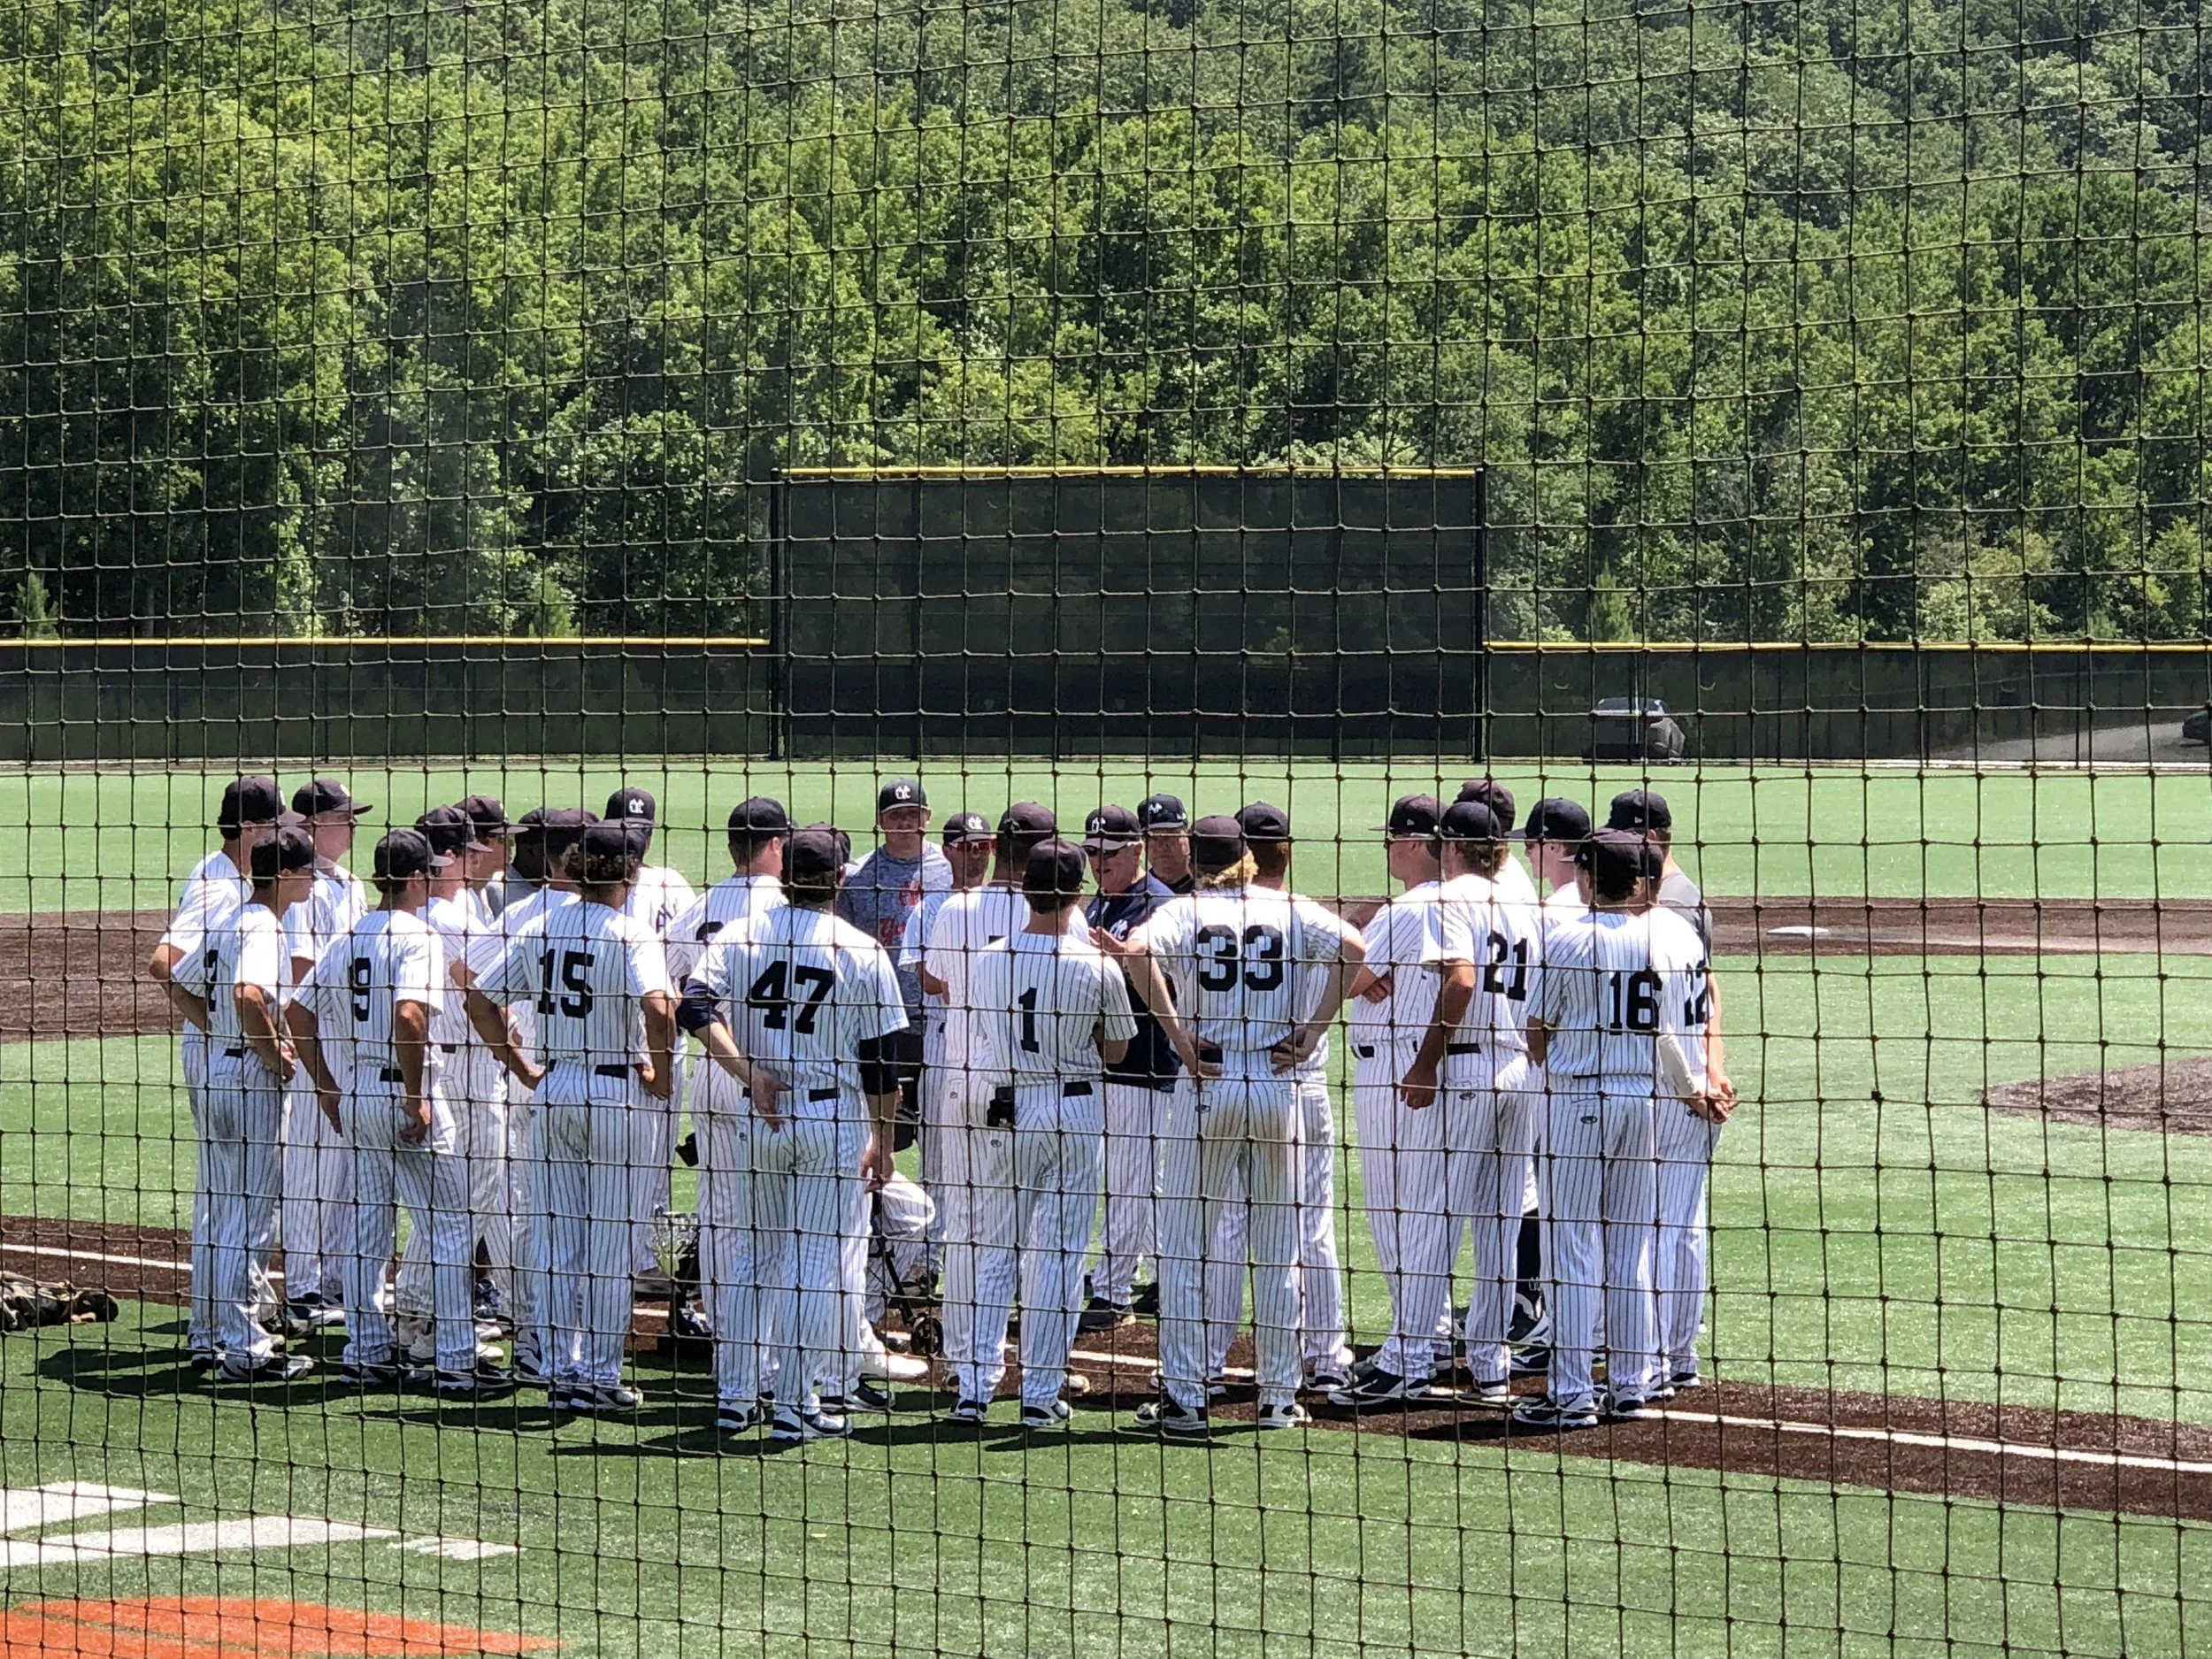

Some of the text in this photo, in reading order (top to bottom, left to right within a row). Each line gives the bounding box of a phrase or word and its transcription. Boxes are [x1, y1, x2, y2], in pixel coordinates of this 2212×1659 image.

[349, 957, 371, 1021] 9
[538, 949, 595, 1018] 15
[1197, 925, 1283, 991] 33
[1484, 930, 1527, 1001] 21
[750, 961, 833, 1034] 47
[1018, 987, 1040, 1053] 1
[1609, 971, 1663, 1035] 16
